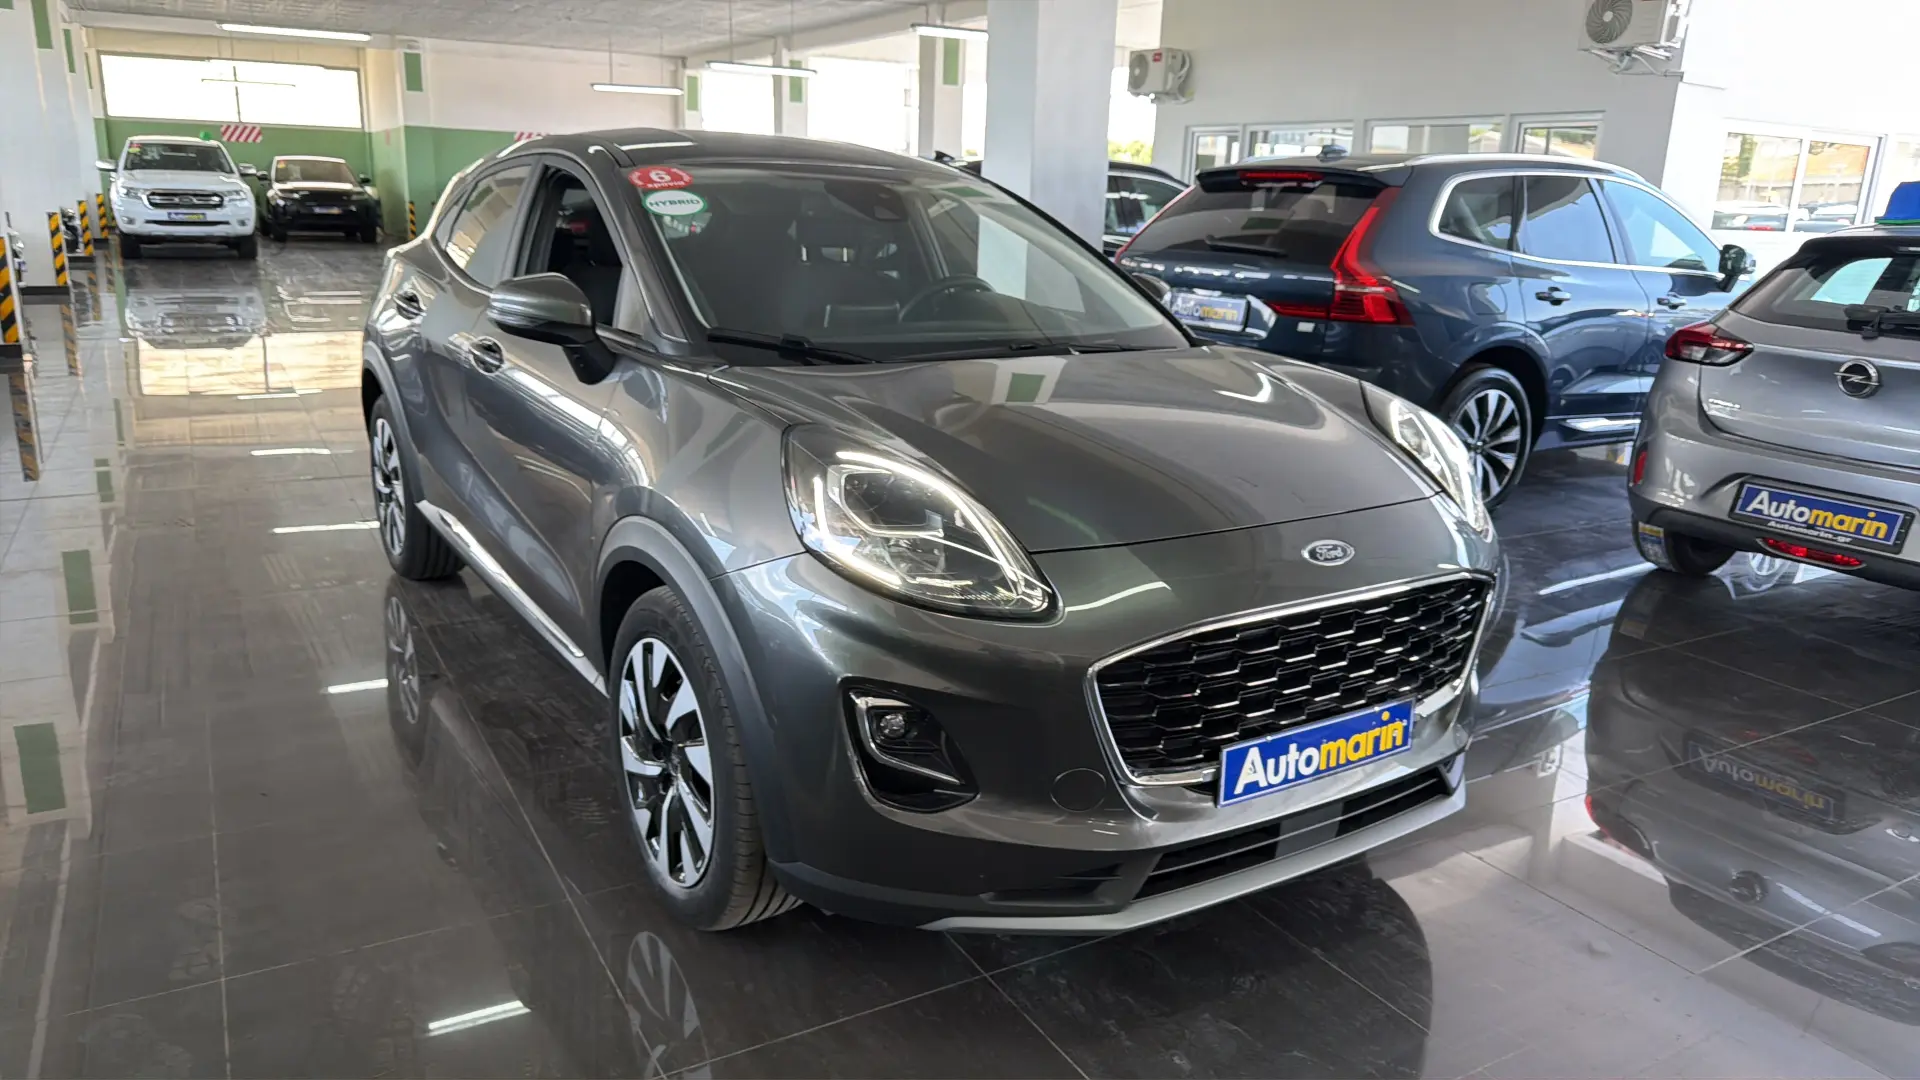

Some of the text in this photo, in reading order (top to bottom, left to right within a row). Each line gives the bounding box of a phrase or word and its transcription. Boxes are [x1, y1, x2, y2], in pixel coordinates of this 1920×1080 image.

[649, 170, 671, 182] 6
[648, 199, 700, 207] HYBRID
[1745, 491, 1888, 539] Automarin
[1315, 545, 1344, 560] Ford
[1234, 711, 1405, 794] Automarin
